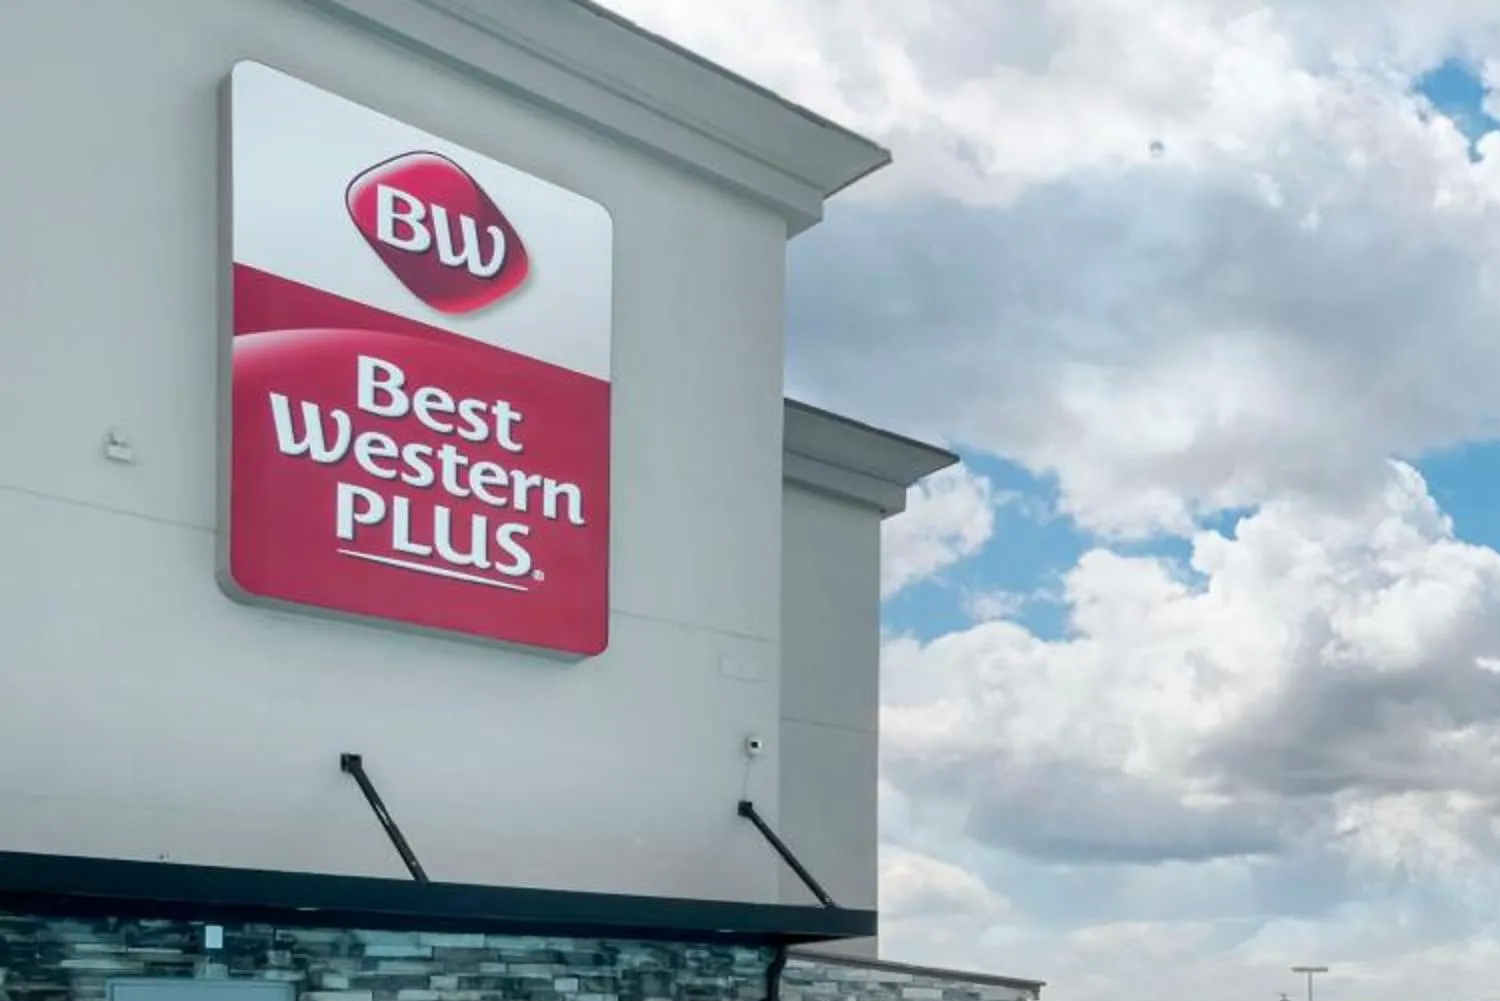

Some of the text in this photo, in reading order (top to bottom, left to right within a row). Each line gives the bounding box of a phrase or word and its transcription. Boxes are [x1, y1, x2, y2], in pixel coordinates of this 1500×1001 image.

[377, 183, 506, 278] BW
[357, 354, 524, 452] Best
[268, 391, 586, 526] Western
